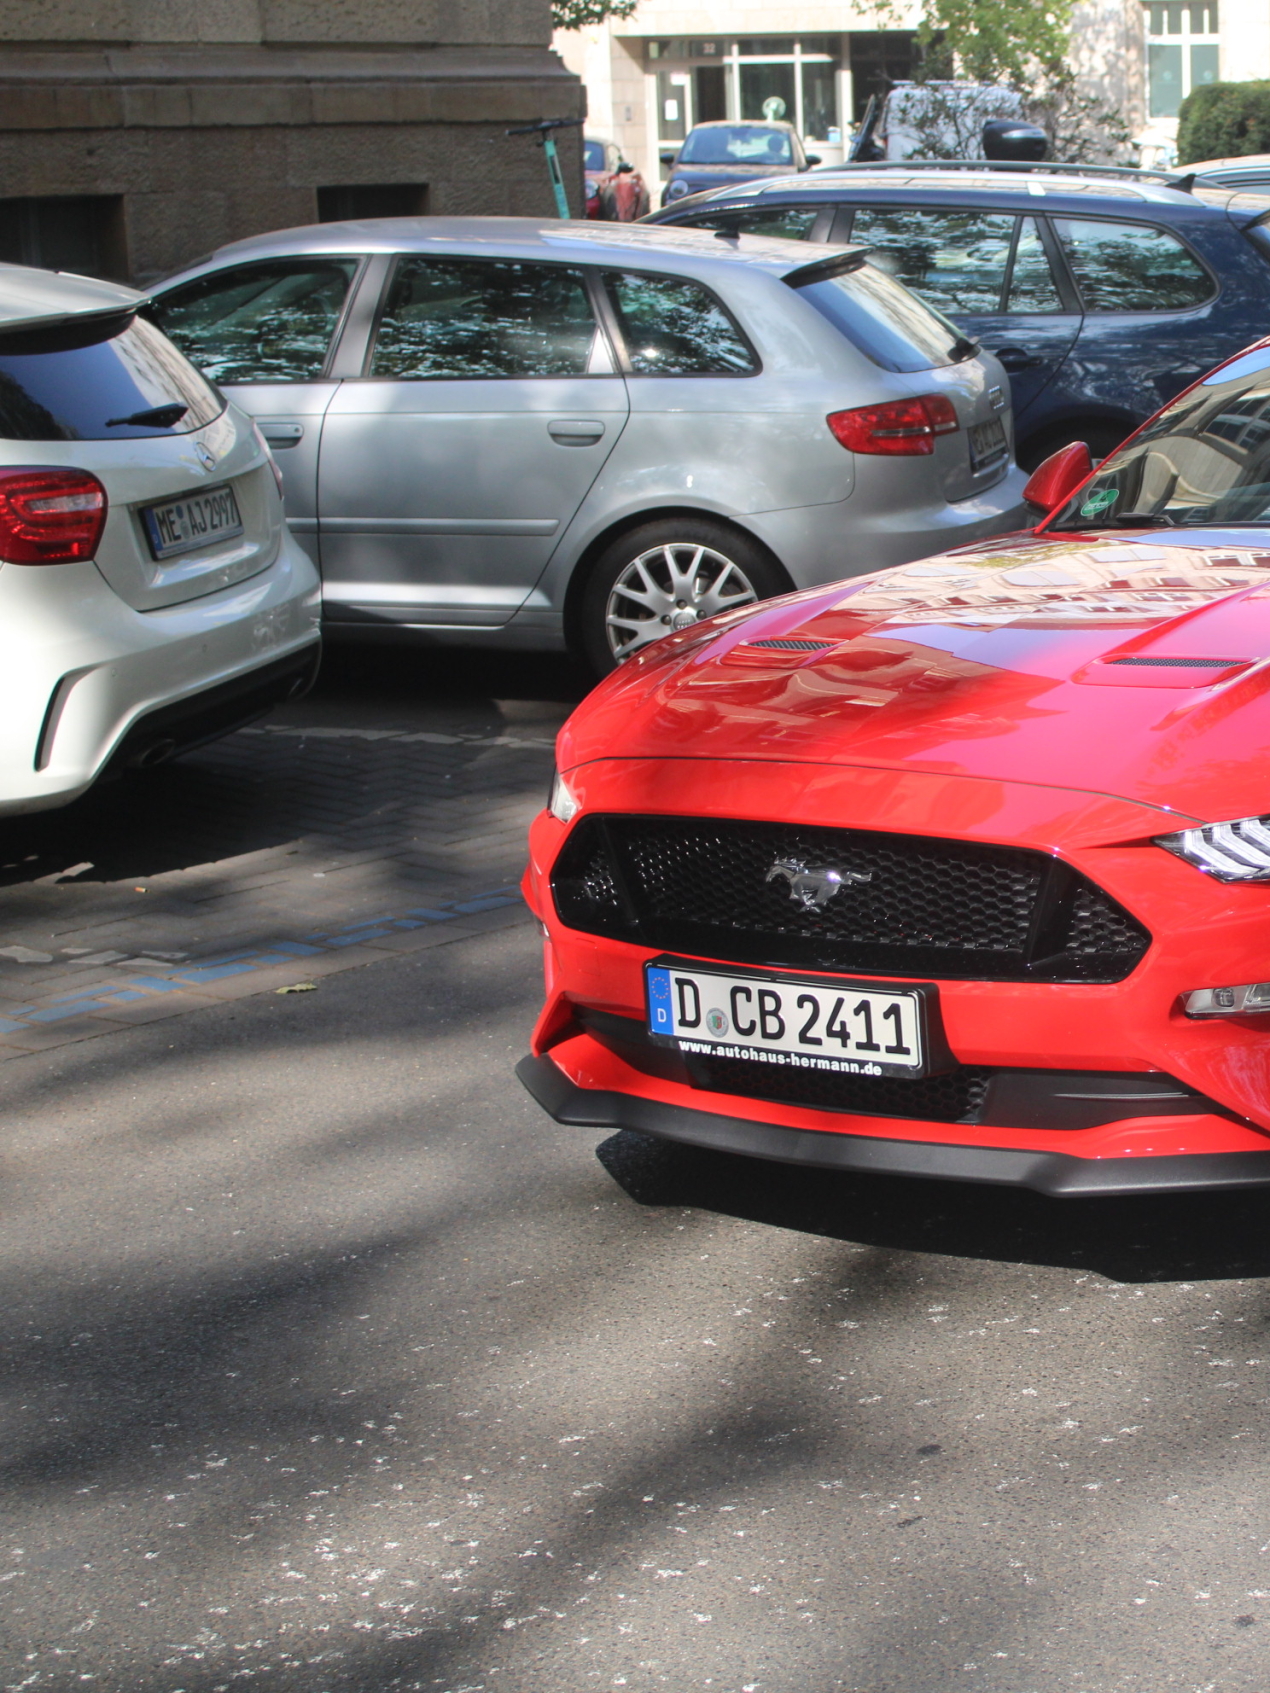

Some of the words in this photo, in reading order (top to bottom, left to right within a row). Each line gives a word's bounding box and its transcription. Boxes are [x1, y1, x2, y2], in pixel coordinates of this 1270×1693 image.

[156, 508, 182, 544] ME
[187, 501, 208, 536] AJ
[657, 1008, 667, 1023] D
[675, 977, 702, 1028] D
[730, 986, 786, 1040] CB
[797, 994, 911, 1055] 2411
[678, 1040, 882, 1076] www.autohaus-hermann.de
